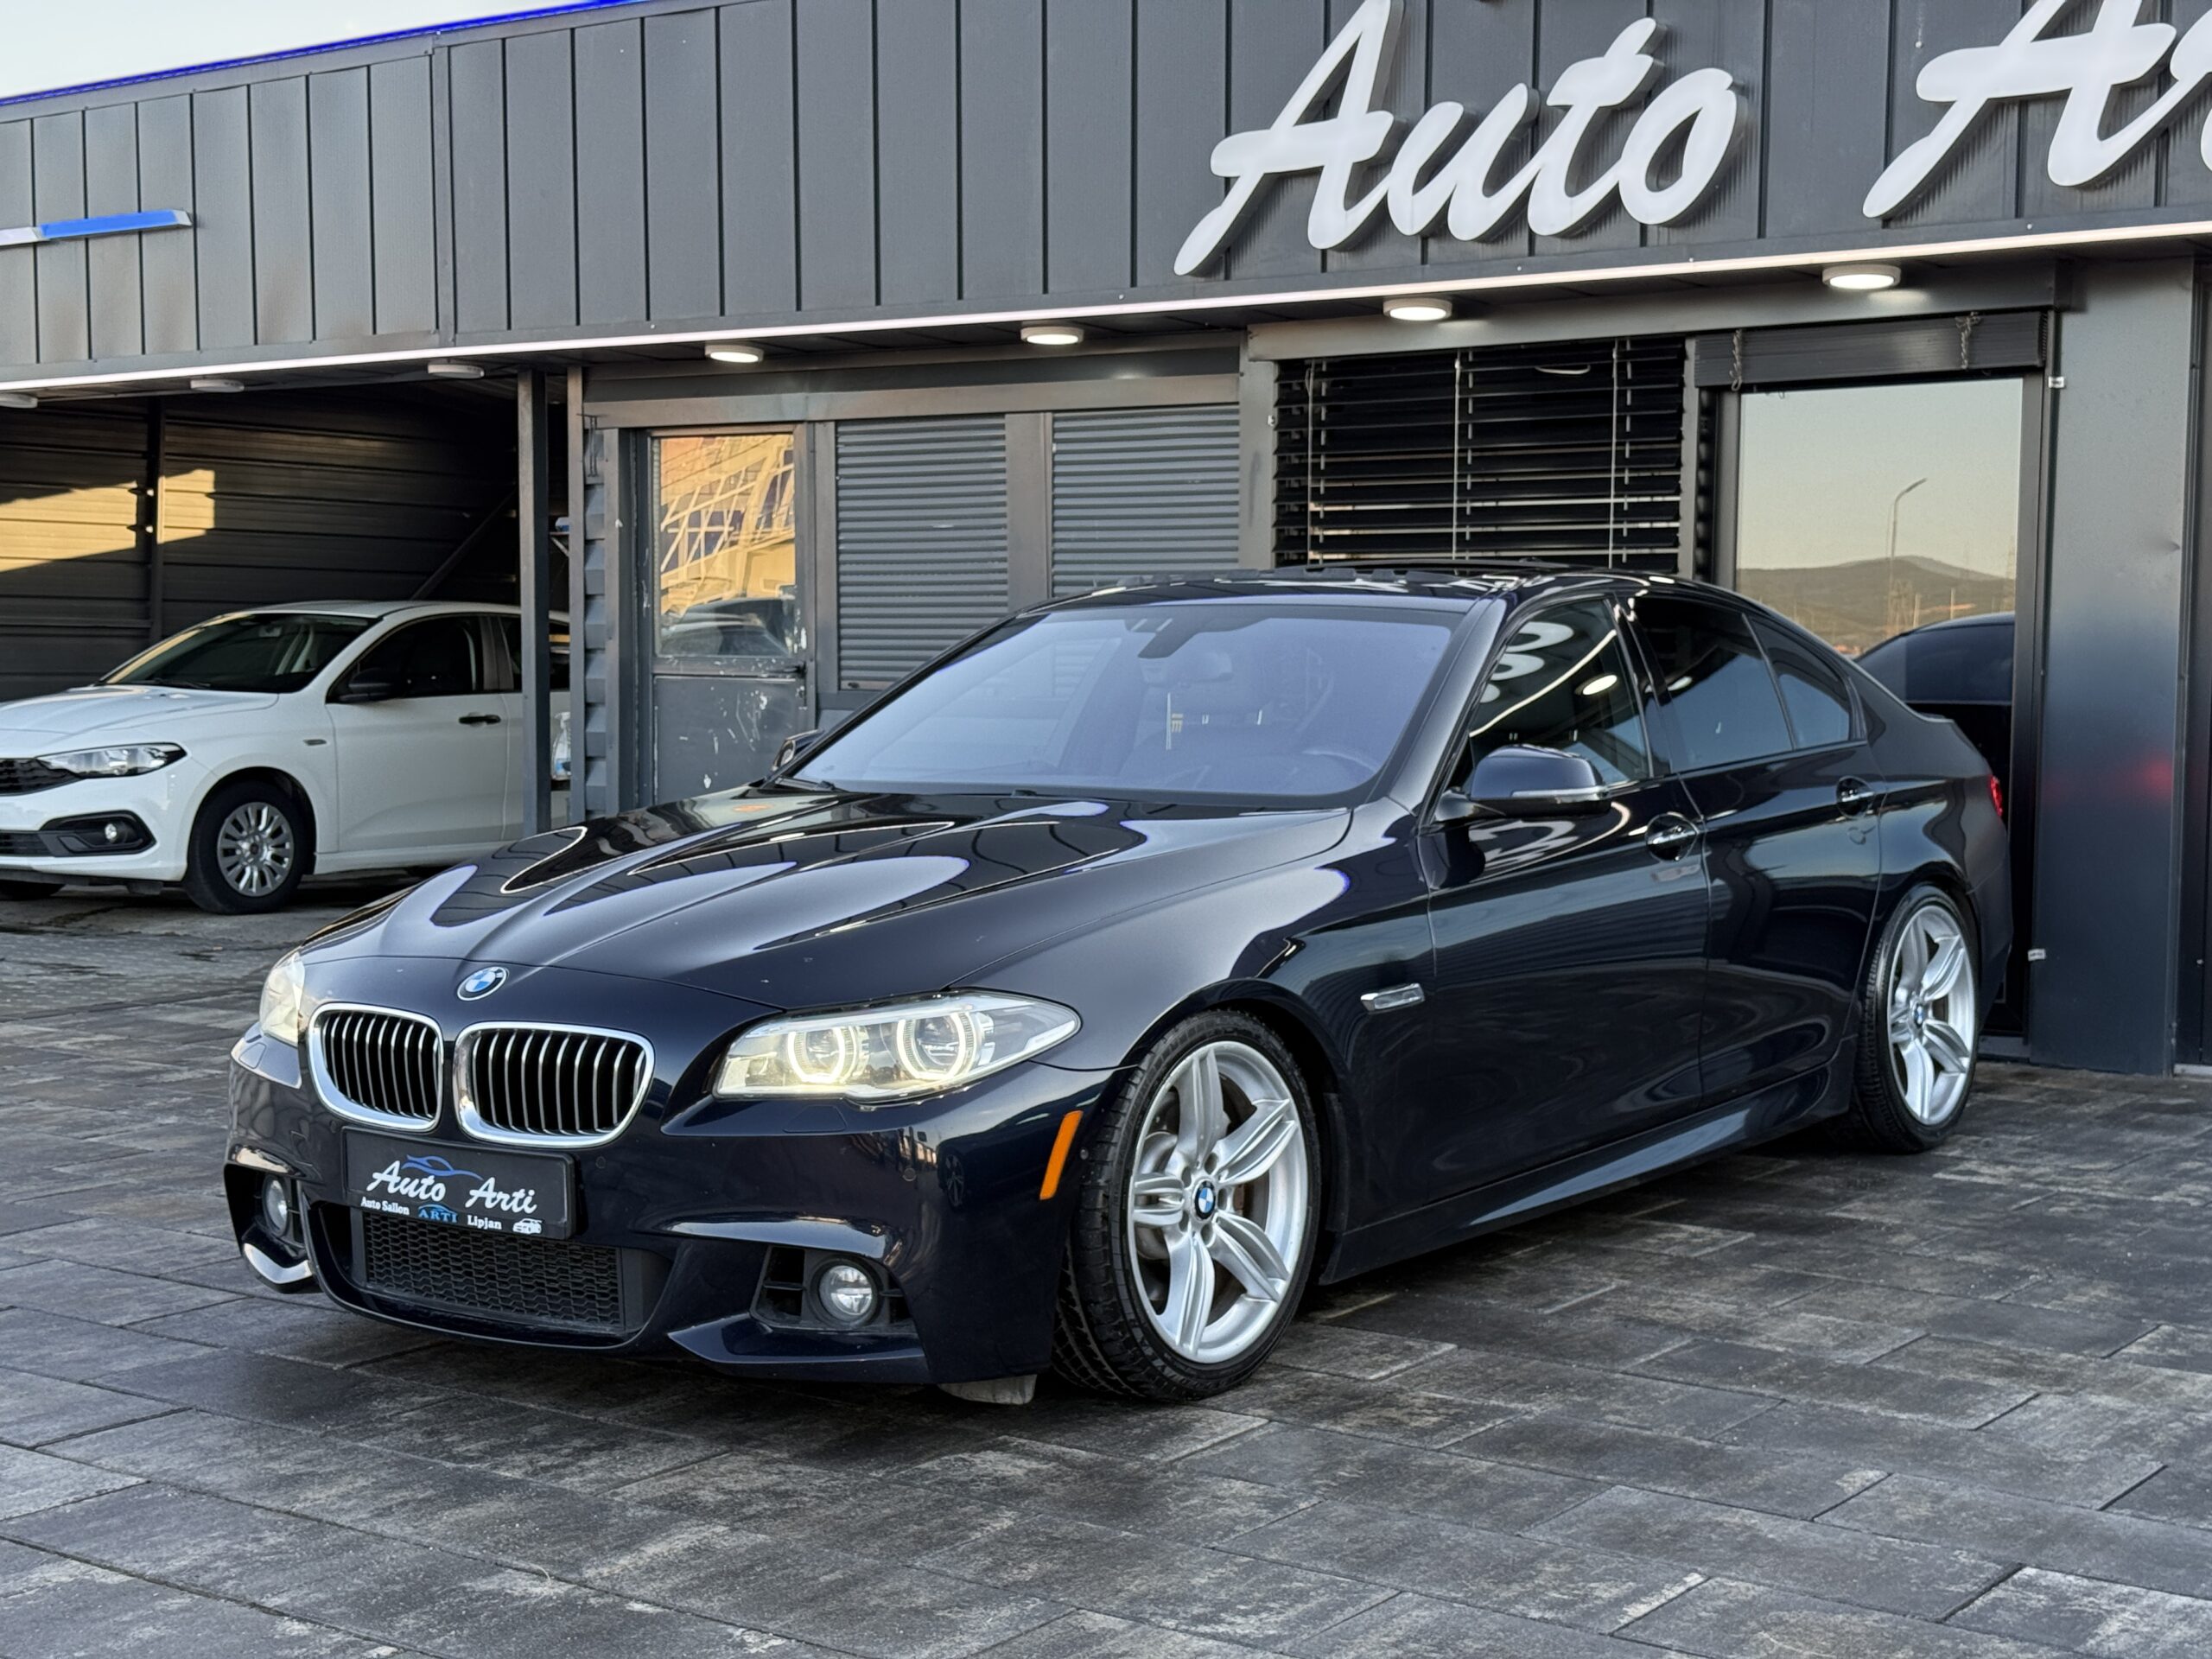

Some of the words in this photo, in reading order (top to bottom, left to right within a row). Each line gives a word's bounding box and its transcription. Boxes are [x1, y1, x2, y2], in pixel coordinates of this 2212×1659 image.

[1175, 0, 1737, 276] Auto
[360, 1196, 381, 1211] Auto
[418, 1209, 458, 1224] ARTI
[467, 1215, 502, 1230] Lipjan
[366, 1160, 446, 1202] Auto
[465, 1177, 537, 1214] Arti
